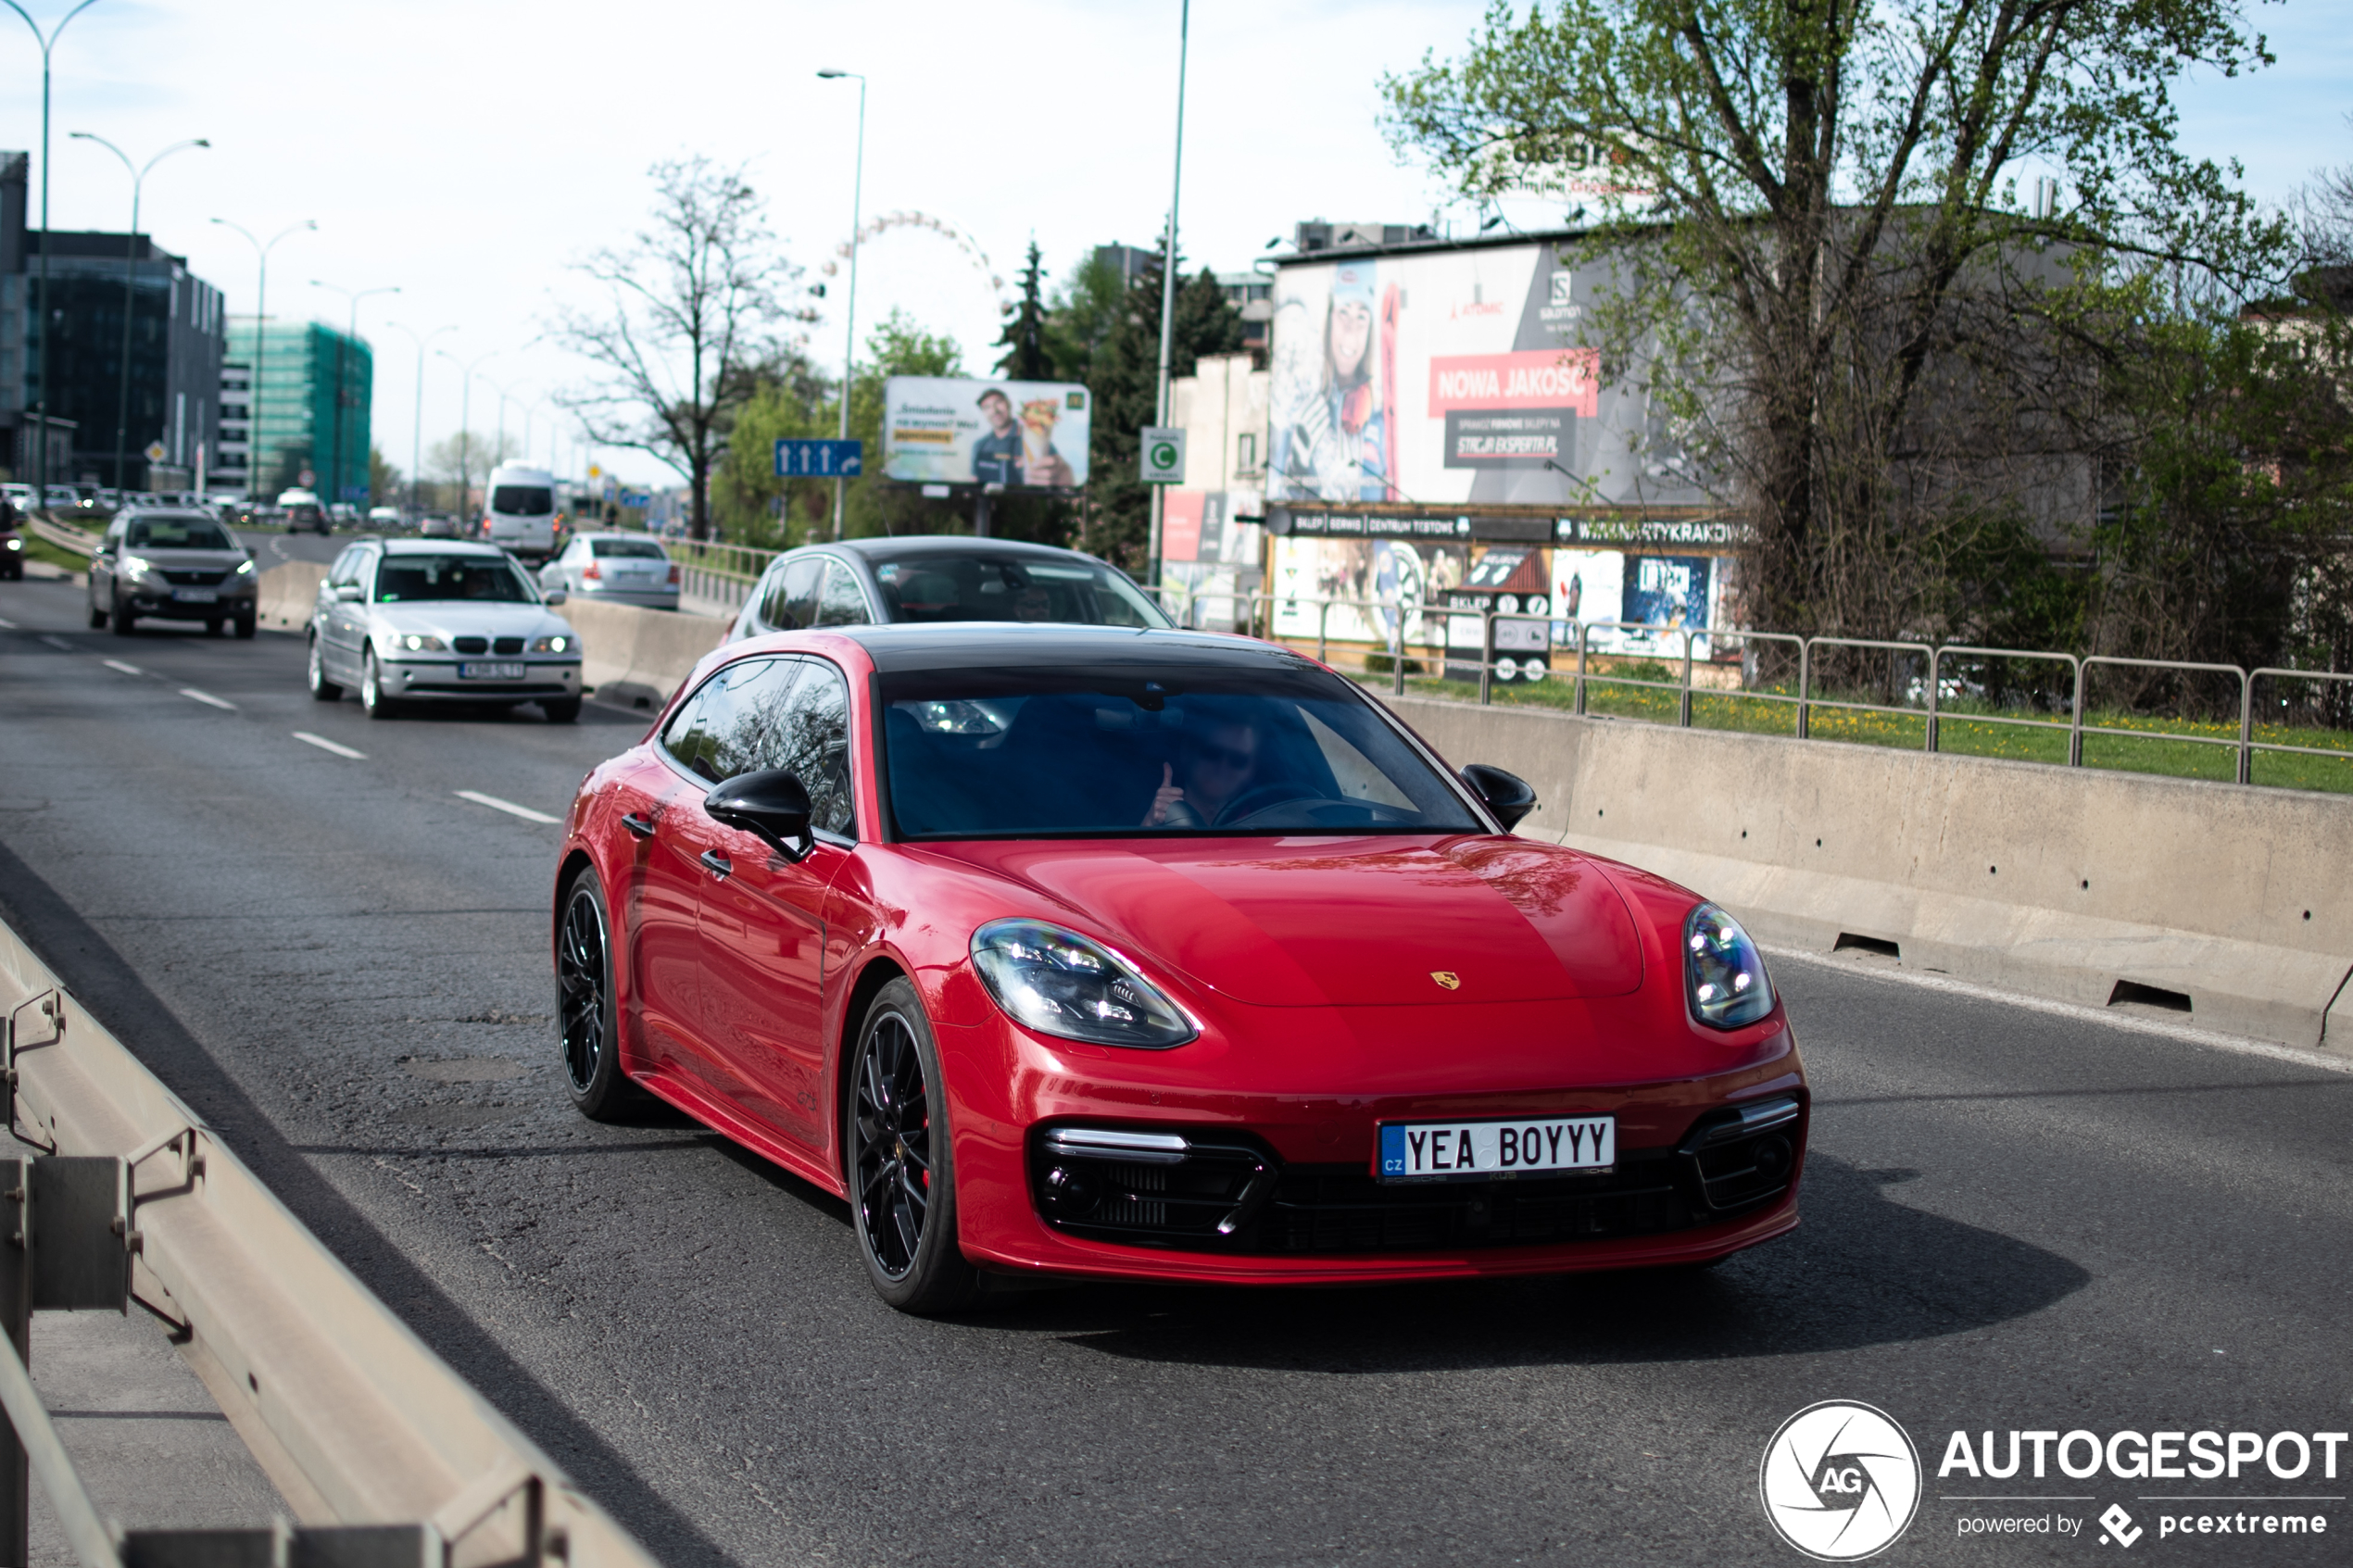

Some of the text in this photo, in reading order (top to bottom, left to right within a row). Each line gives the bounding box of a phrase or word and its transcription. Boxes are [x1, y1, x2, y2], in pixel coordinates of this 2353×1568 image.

[1463, 301, 1504, 316] ATOMIC
[1438, 370, 1501, 399] NOWA
[1297, 517, 1454, 534] SKLEP SERWIS CENTRUM TESTOWE
[1450, 596, 1491, 608] SKLEP
[1407, 1123, 1606, 1171] YEA BOYYY
[1385, 1160, 1403, 1171] CZ
[1557, 1166, 1614, 1176] PORSCHE
[1385, 1175, 1447, 1184] PORSCHE
[1489, 1171, 1517, 1181] KUS
